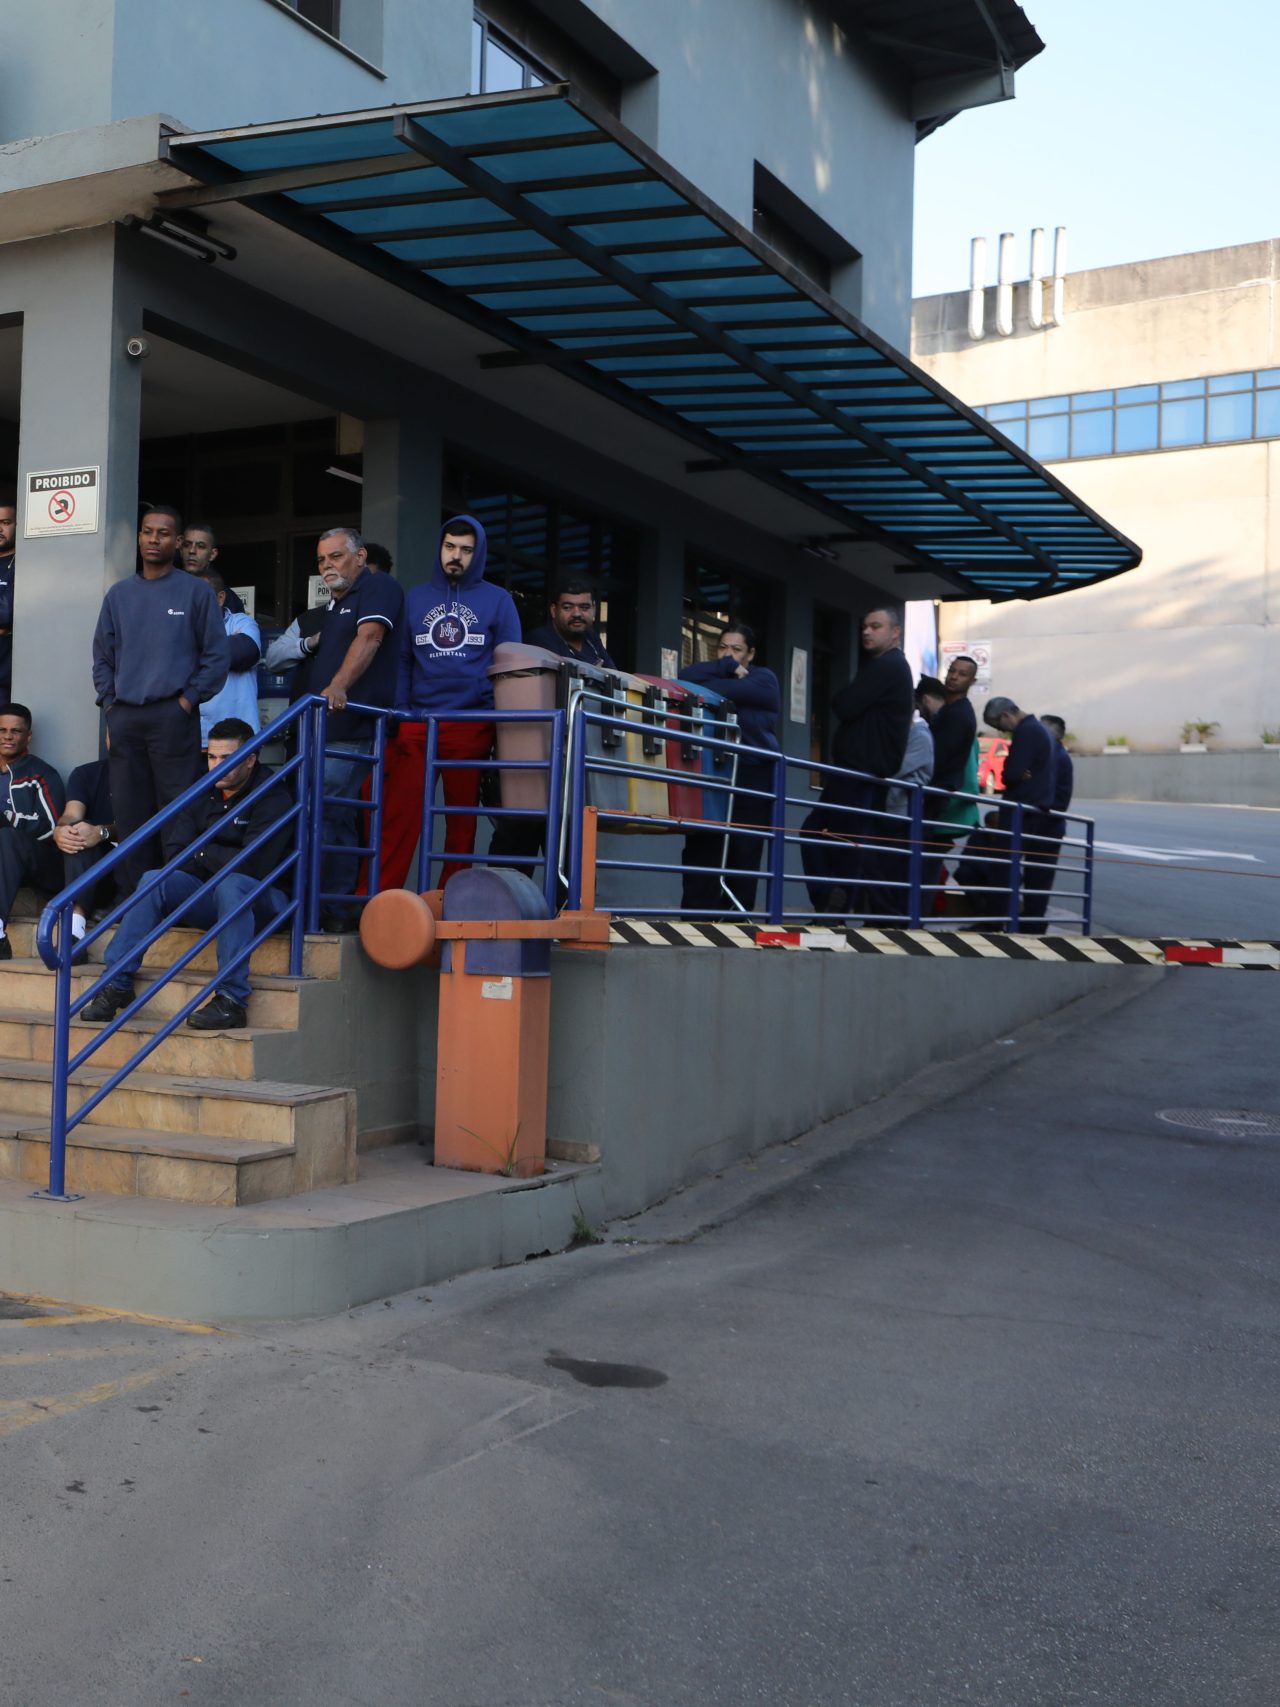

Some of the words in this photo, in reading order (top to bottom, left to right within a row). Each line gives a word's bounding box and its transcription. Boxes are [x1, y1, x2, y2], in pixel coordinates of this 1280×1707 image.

[36, 474, 90, 489] PROIBIDO
[318, 587, 330, 595] POR
[422, 604, 446, 628] NEW
[451, 602, 478, 627] YORK
[440, 622, 458, 642] NY
